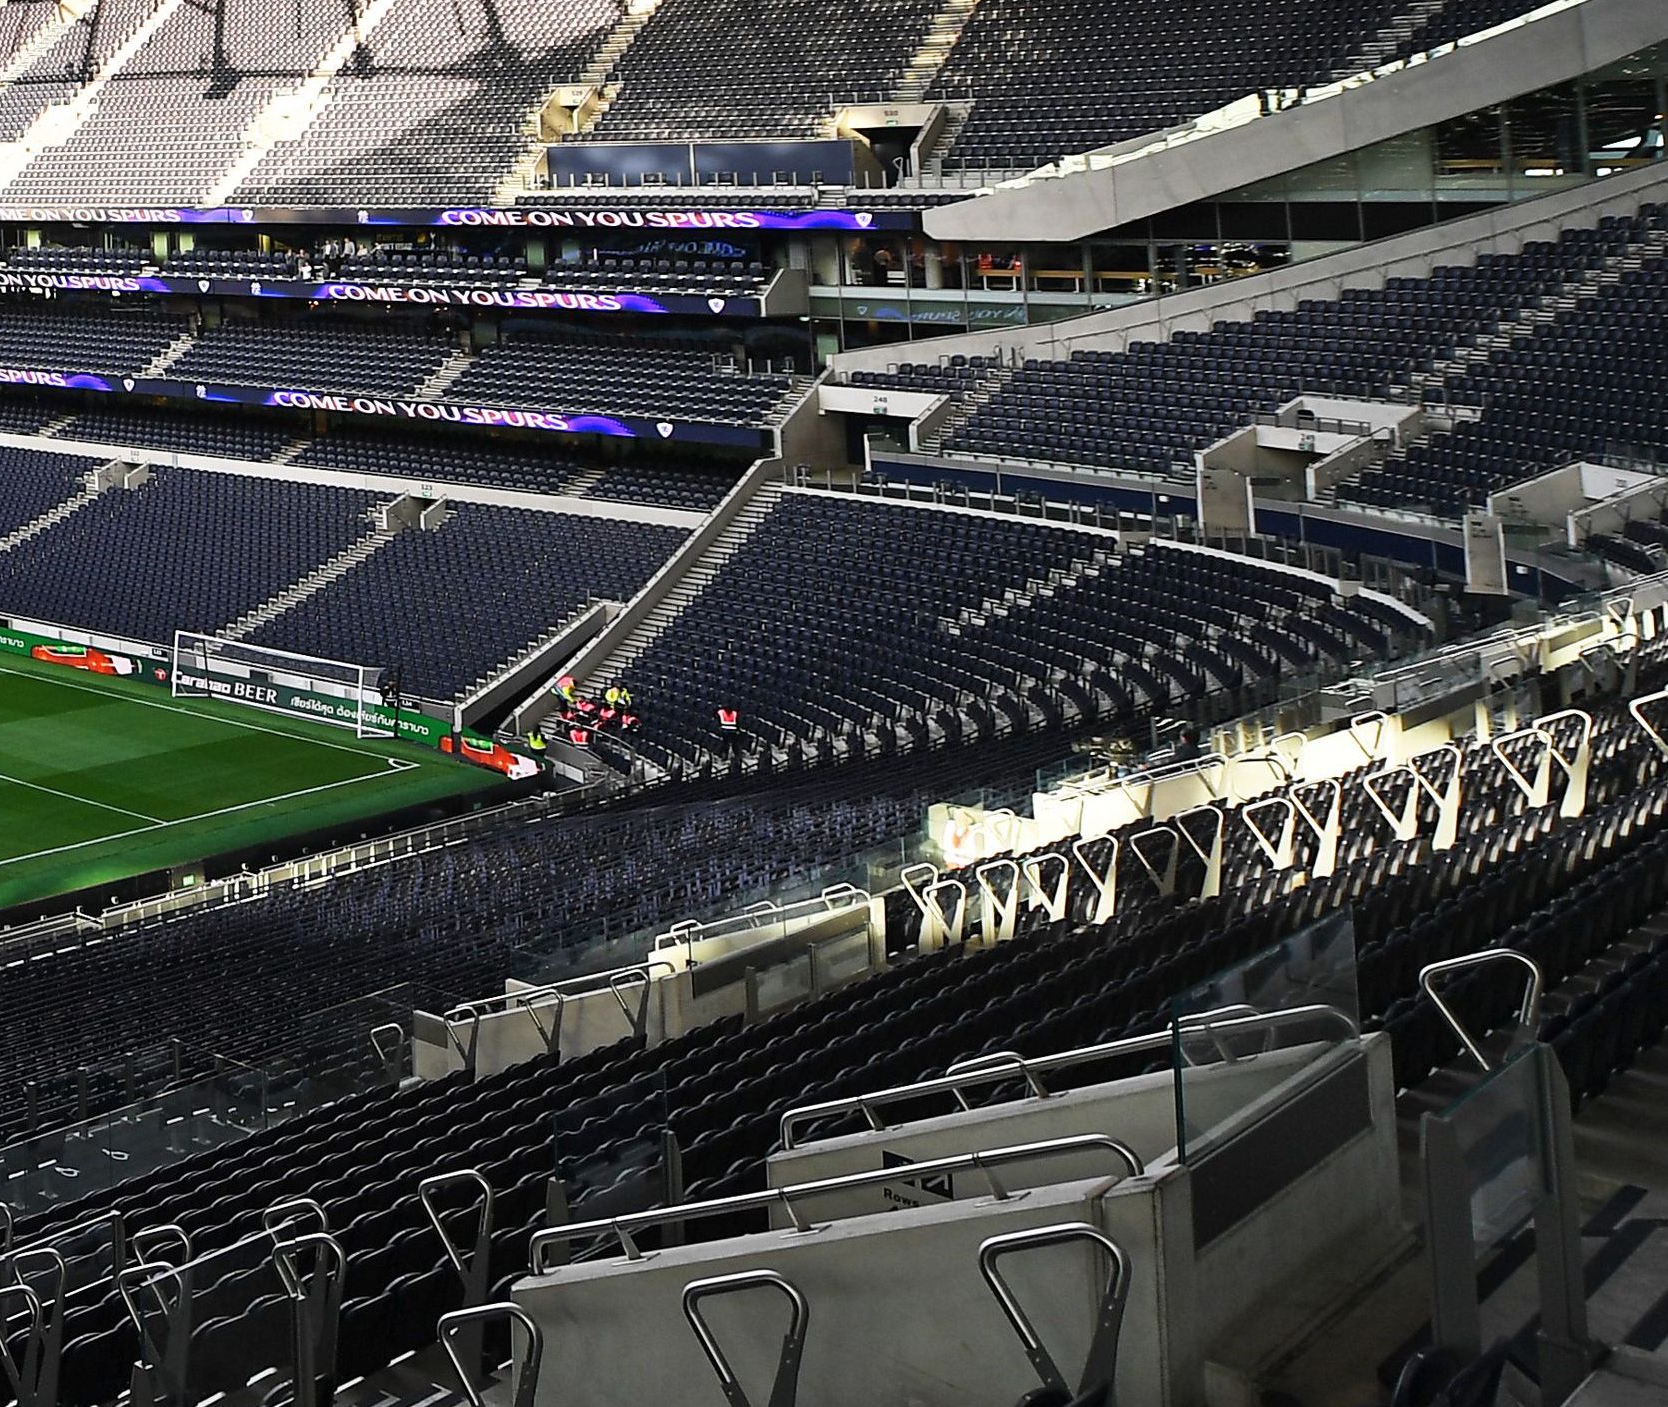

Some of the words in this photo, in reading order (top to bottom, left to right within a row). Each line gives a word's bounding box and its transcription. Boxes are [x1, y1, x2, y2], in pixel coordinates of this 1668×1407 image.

[31, 208, 64, 223] ON
[442, 210, 528, 226] COME
[528, 211, 574, 227] ON
[575, 212, 644, 228] YOU
[645, 212, 761, 228] SPURS
[23, 274, 67, 288] YOU
[67, 276, 140, 291] SPURS
[329, 285, 408, 302] COME
[408, 288, 451, 304] ON
[452, 290, 513, 306] YOU
[515, 292, 621, 310] SPURS
[274, 391, 351, 410] COME
[351, 397, 396, 416] ON
[397, 402, 462, 421] YOU
[464, 406, 568, 430] SPURS
[234, 683, 278, 704] BEER
